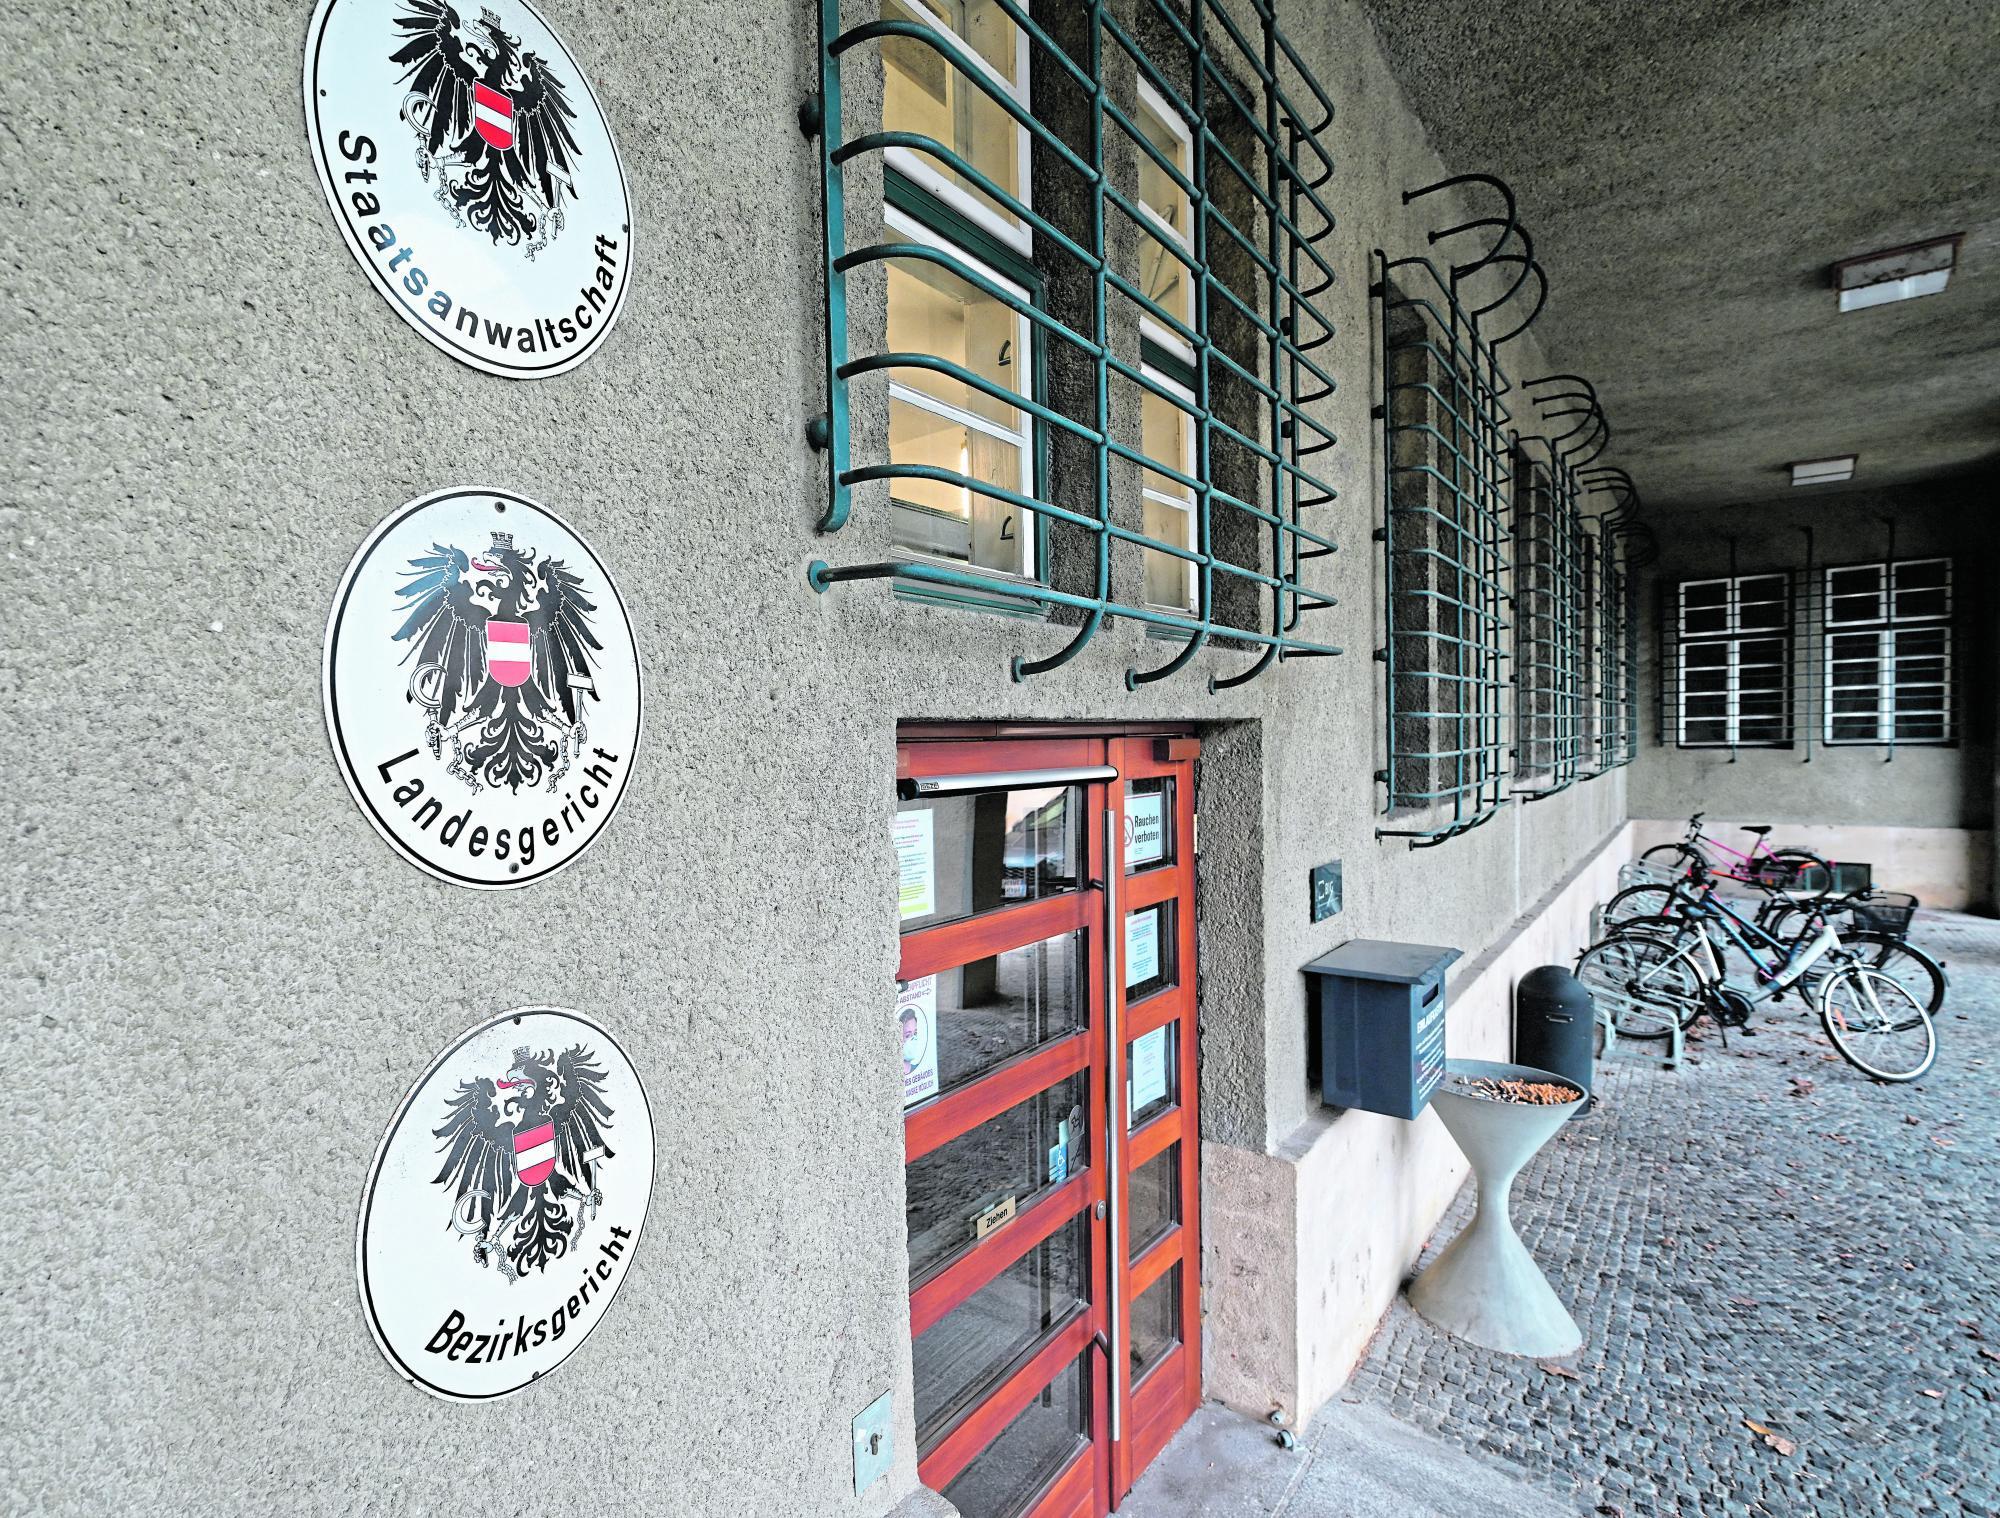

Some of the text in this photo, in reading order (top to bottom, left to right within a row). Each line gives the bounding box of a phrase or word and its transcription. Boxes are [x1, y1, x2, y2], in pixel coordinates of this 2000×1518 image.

[338, 130, 618, 353] Staatsanwaltschaft
[377, 747, 619, 865] Landesgericht
[1134, 813, 1160, 828] Rauchen
[1134, 830, 1160, 844] verboten
[986, 1208, 1008, 1229] Ziehen
[424, 1225, 632, 1364] Bezirksgericht
